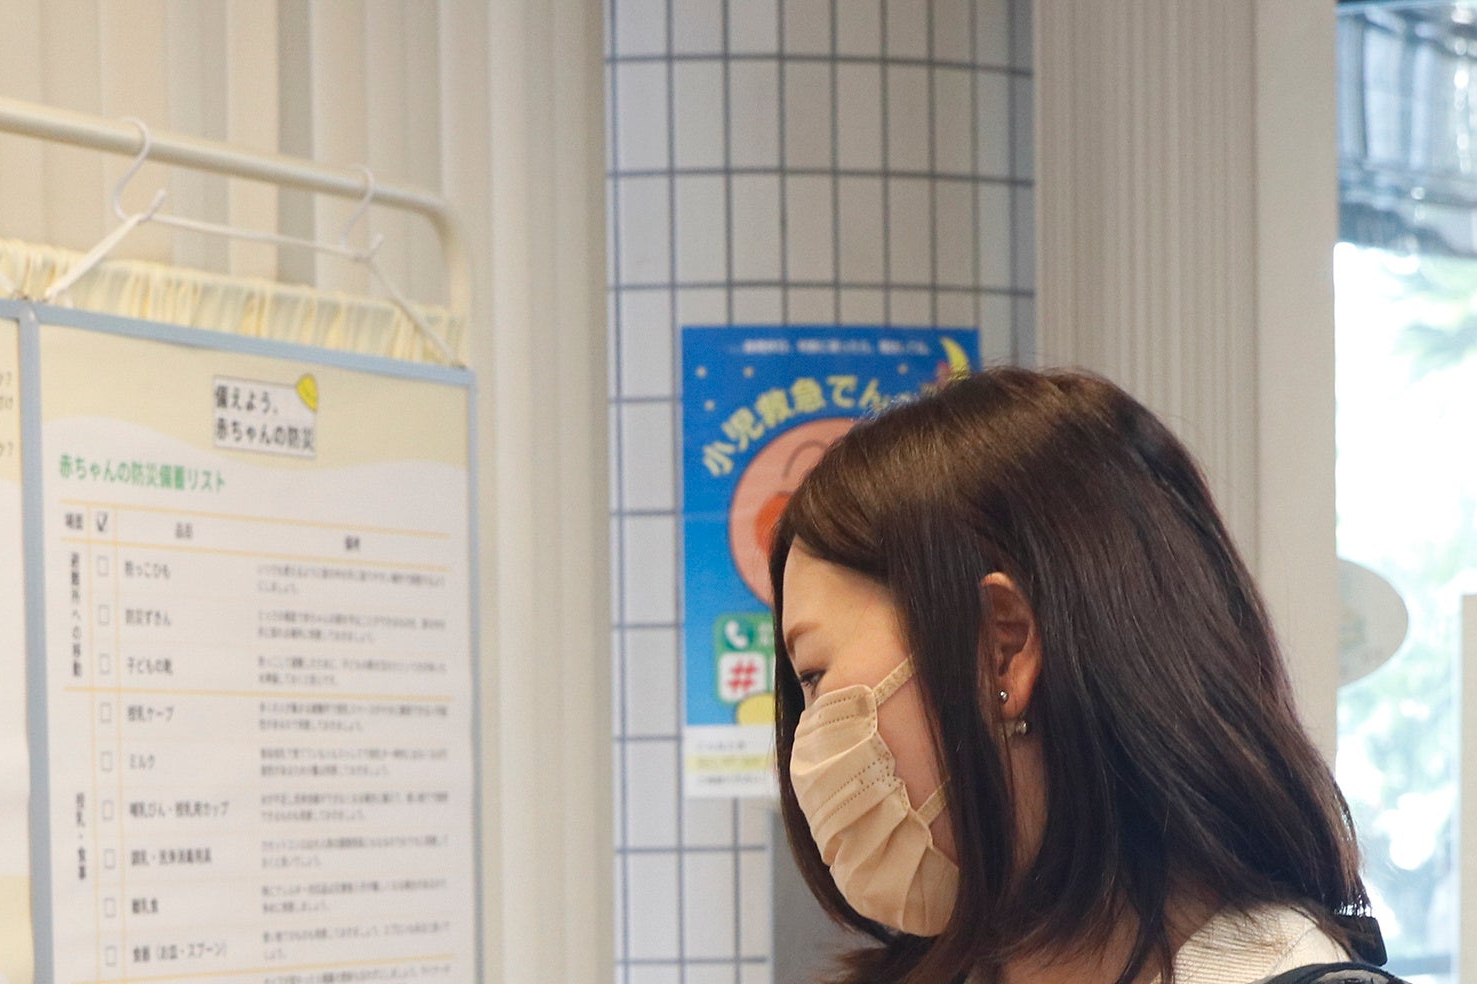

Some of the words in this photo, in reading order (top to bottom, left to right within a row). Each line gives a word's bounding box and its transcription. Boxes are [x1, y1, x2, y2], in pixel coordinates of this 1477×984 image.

[215, 418, 314, 453] 赤ちゃんの防災
[702, 374, 886, 478] 小児救急でん
